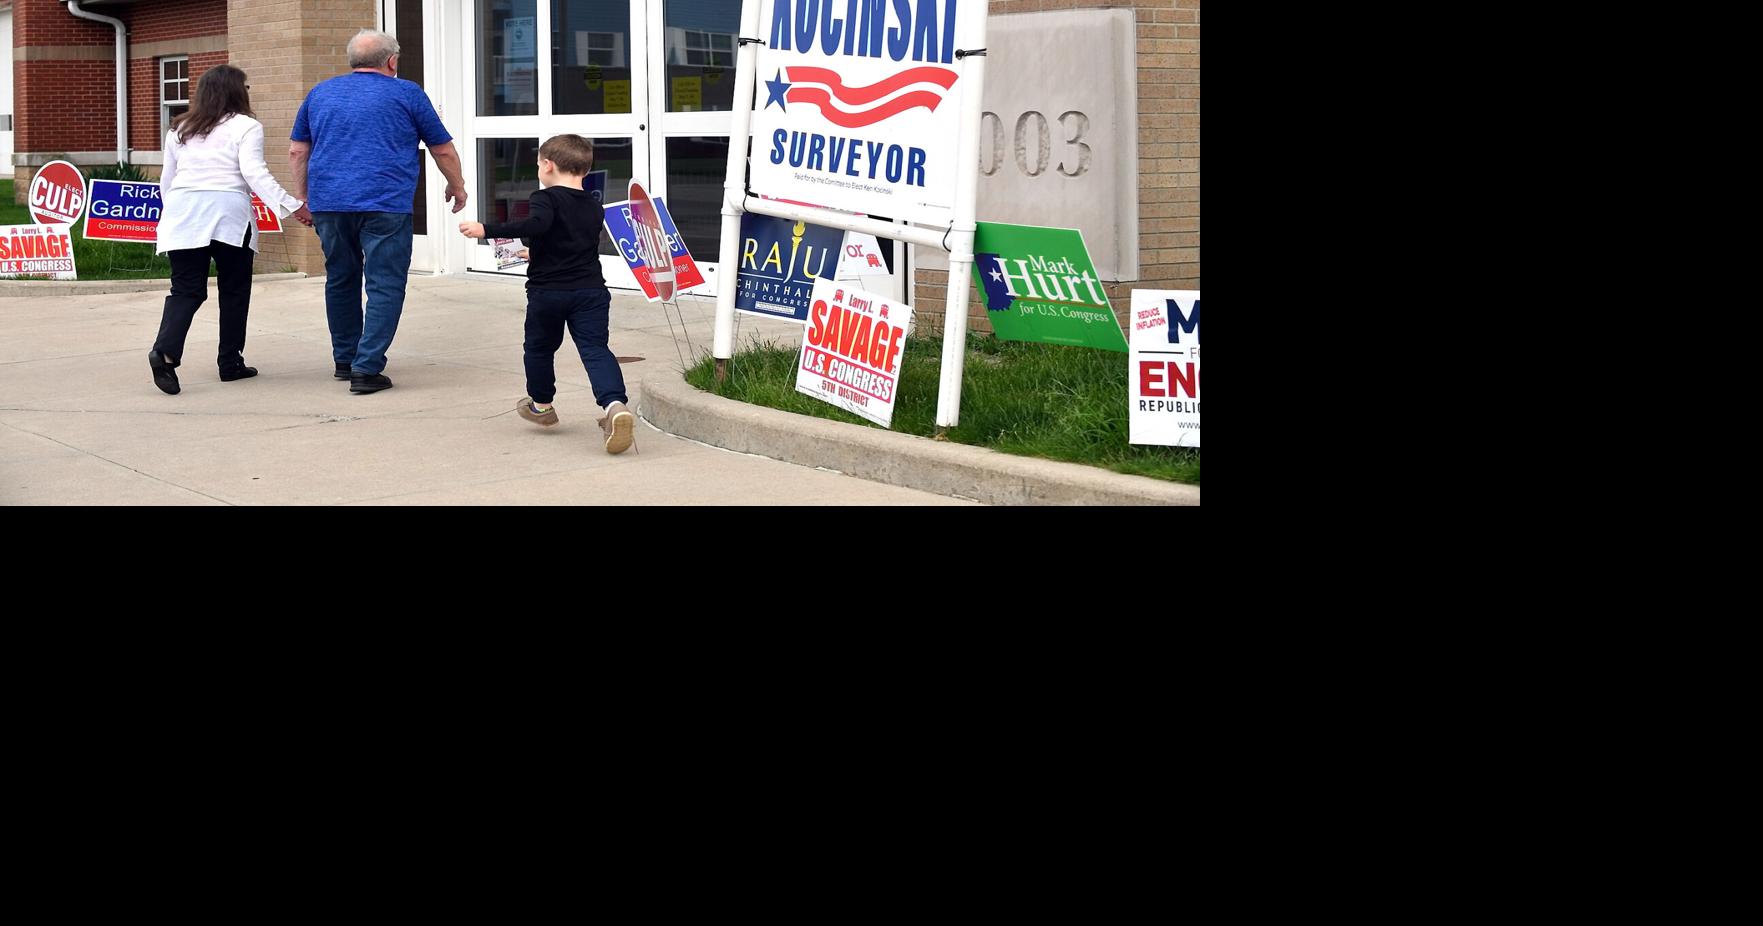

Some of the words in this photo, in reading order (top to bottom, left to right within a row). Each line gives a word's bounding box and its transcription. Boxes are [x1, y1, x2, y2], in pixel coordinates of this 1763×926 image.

[769, 128, 926, 187] SURVEYOR
[32, 175, 82, 216] CULP
[65, 183, 82, 196] ELECT
[120, 184, 160, 199] Rick
[91, 199, 160, 219] Gardn
[0, 234, 69, 260] SAVAGE
[1, 261, 20, 272] U.S.
[22, 260, 71, 271] CONGRESS
[741, 236, 827, 284] RAJU
[1027, 254, 1078, 275] Mark
[736, 279, 811, 299] CHINTHAL
[993, 257, 1106, 305] Hurt
[739, 290, 756, 299] FOR
[762, 294, 808, 307] CONGRES
[848, 294, 868, 313] Larry
[868, 300, 874, 315] L.
[1019, 302, 1035, 316] for
[1036, 304, 1060, 317] U.S.
[1060, 306, 1109, 324] Congress
[1136, 316, 1166, 331] INFLATION
[1137, 307, 1160, 320] REDUCE
[808, 299, 904, 373] SAVAGE
[804, 349, 826, 375] U.S.
[828, 358, 892, 400] CONGRESS
[1139, 361, 1200, 398] EN
[821, 380, 836, 394] 5TH
[838, 387, 870, 407] DISTRICT
